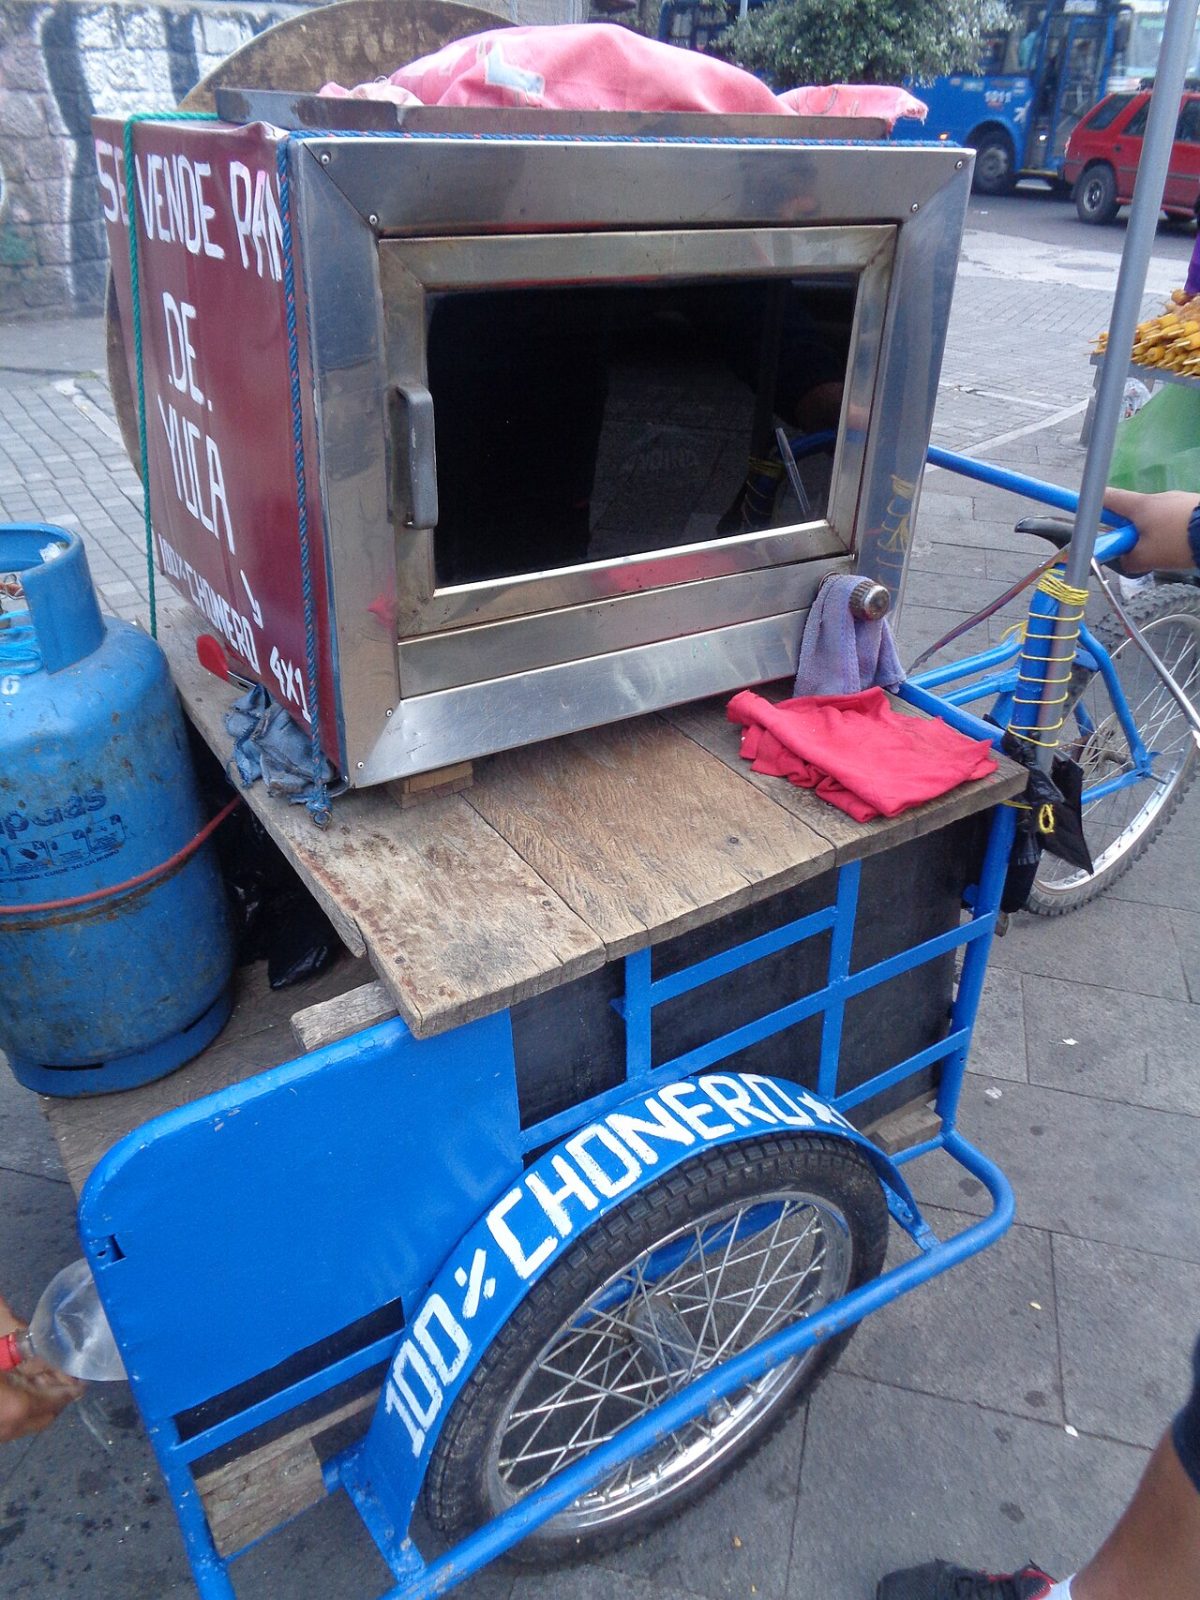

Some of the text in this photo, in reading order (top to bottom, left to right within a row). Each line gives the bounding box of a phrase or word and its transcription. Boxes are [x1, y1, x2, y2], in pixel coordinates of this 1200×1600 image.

[95, 138, 284, 282] SE VENDE PAN
[157, 394, 237, 556] YUCA
[184, 560, 262, 675] CHONERO
[486, 1072, 816, 1279] CHONERO
